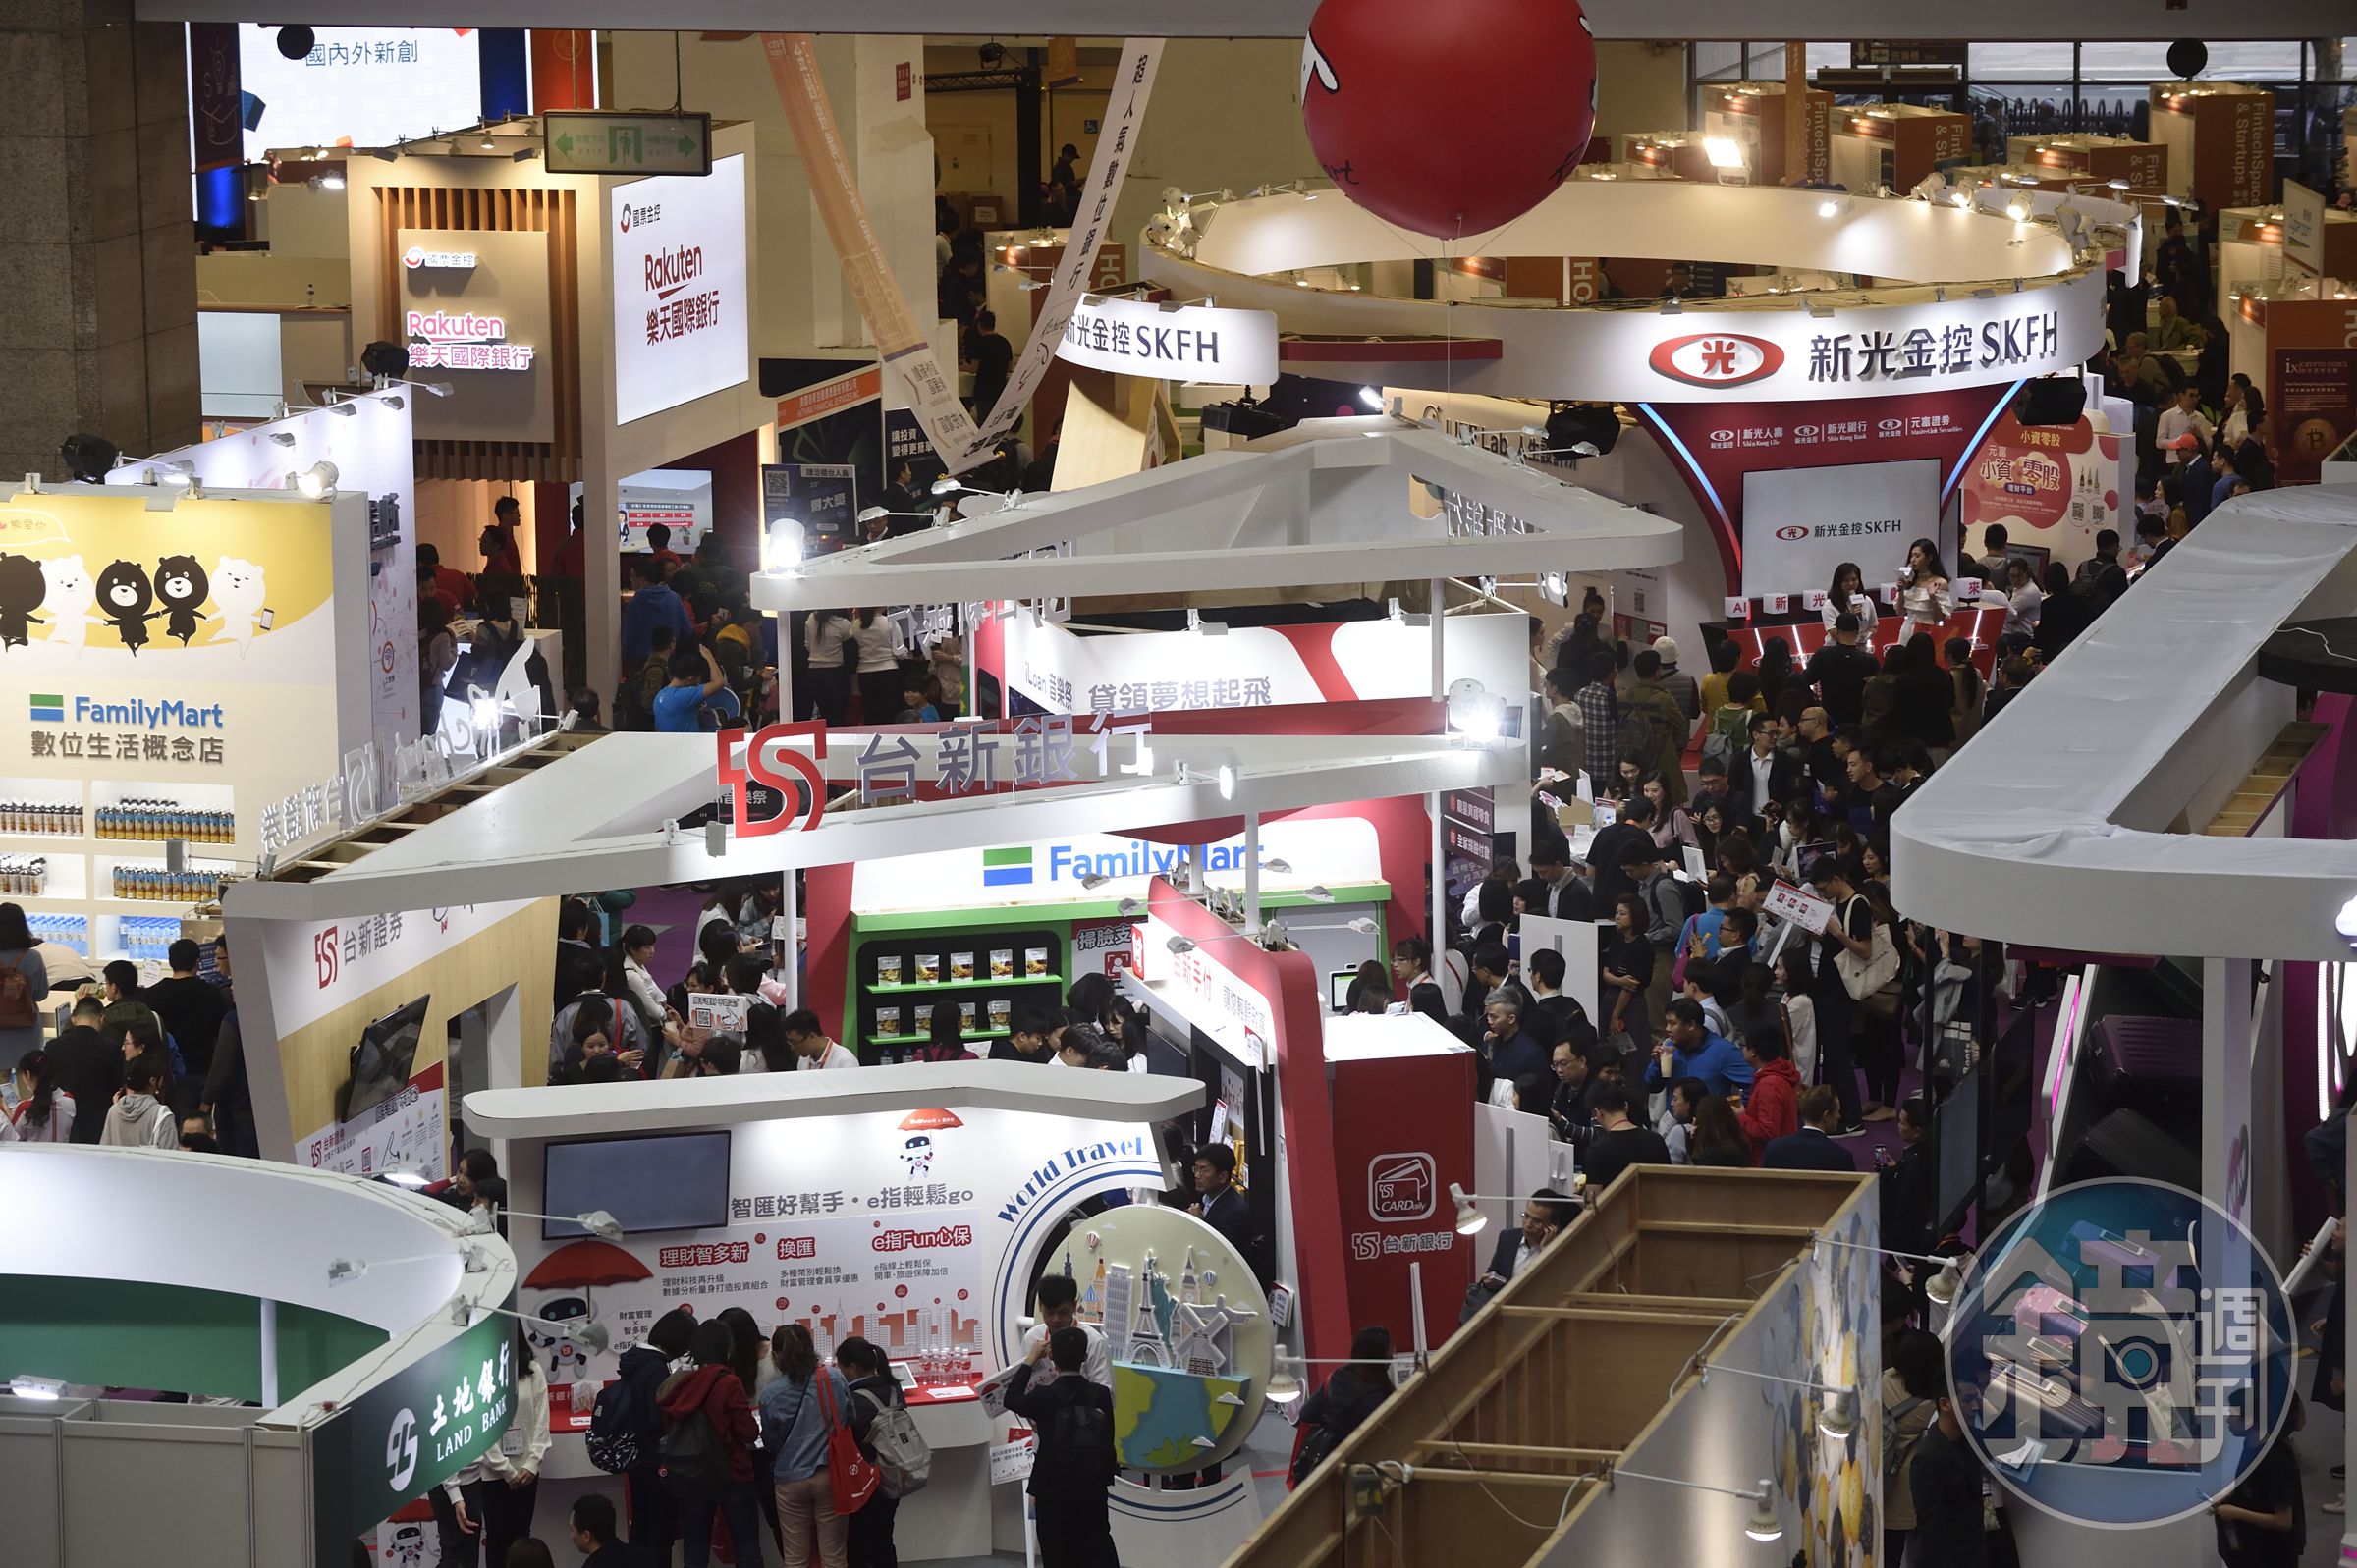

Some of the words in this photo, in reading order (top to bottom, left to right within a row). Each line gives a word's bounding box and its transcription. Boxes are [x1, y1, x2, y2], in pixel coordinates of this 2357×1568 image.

[305, 39, 419, 67] 國內外新創
[644, 244, 703, 292] Rakuten
[408, 312, 503, 337] Rakuten
[646, 290, 720, 346] 樂天國際銀行
[410, 345, 532, 368] 樂天國際銀行
[1136, 325, 1220, 363] SKFH
[1808, 322, 1974, 382] 新光金控
[1980, 310, 2059, 367] SKFH
[1481, 426, 1509, 458] Lab
[1827, 421, 1868, 435] 新光銀行
[2021, 430, 2060, 447] 小資零股
[1988, 445, 2007, 458] 元富
[1981, 459, 2012, 481] 小資
[2023, 459, 2060, 491] 零股
[1813, 521, 1863, 538] 新光金控
[1865, 520, 1902, 536] SKFH
[1732, 603, 1747, 613] AI
[1775, 596, 1787, 611] 新
[1088, 675, 1273, 716] 貸領夢想起飛
[75, 696, 224, 729] FamilyMart
[30, 731, 225, 764] 數位生活概念店
[856, 708, 1154, 804] 台新銀行
[1078, 921, 1134, 951] 掃臉支
[997, 1160, 1062, 1223] World
[1061, 1137, 1143, 1169] Travel
[1381, 1200, 1427, 1213] CARDaily
[777, 1236, 816, 1260] 換匯
[871, 1225, 972, 1252] e指Fun心保
[1383, 1231, 1453, 1254] 台新銀行
[659, 1243, 749, 1268] 理財智多新
[662, 1273, 725, 1286] 理財科技再升級
[429, 1340, 510, 1436] 土地銀行
[436, 1425, 473, 1462] LAND
[481, 1395, 508, 1433] BANK
